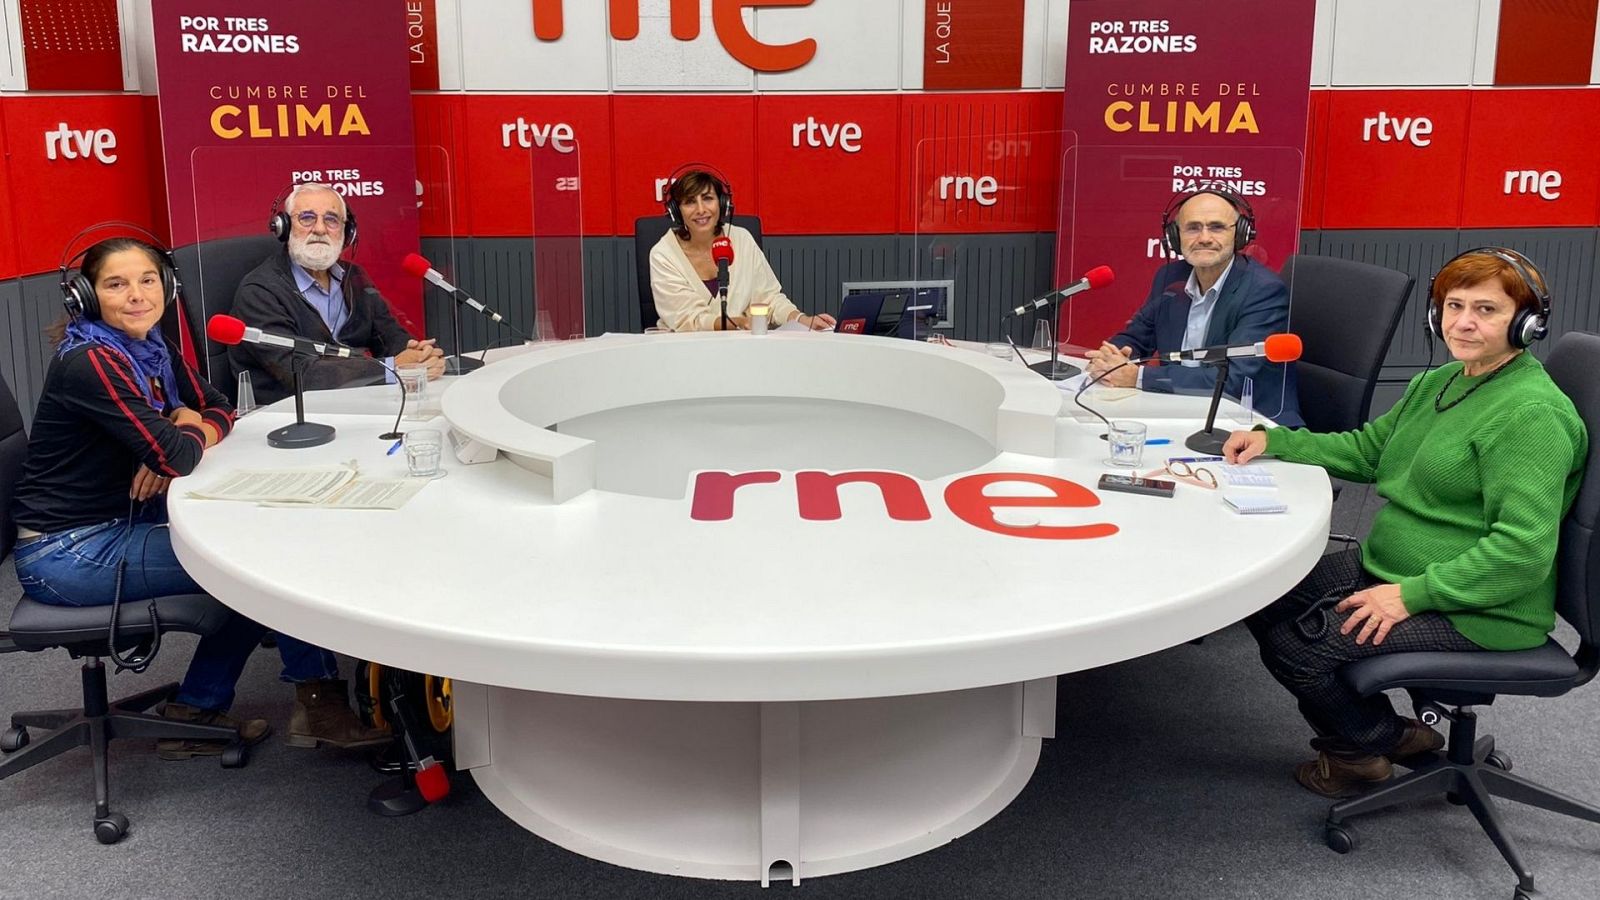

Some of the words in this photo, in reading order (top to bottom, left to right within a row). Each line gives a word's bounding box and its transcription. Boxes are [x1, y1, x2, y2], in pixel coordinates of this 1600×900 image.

[179, 15, 220, 31] POR
[224, 17, 269, 32] TRES
[407, 1, 424, 39] QUE
[936, 2, 951, 39] QUE
[1090, 21, 1125, 35] POR
[1129, 19, 1170, 34] TRES
[181, 33, 300, 54] RAZONES
[409, 42, 425, 64] LA
[935, 42, 951, 64] LA
[1089, 34, 1198, 54] RAZONES
[209, 85, 309, 100] CUMBRE
[327, 85, 367, 99] DEL
[1107, 83, 1200, 96] CUMBRE
[1219, 83, 1261, 96] DEL
[210, 103, 371, 139] CLIMA
[1104, 100, 1260, 134] CLIMA
[1363, 111, 1434, 147] rtve
[44, 122, 117, 164] rtve
[501, 117, 575, 153] rtve
[792, 116, 863, 153] rtve
[292, 170, 323, 183] POR
[325, 168, 361, 181] TRES
[1173, 165, 1204, 178] POR
[1206, 166, 1243, 179] TRES
[1503, 169, 1563, 200] rne
[293, 181, 385, 198] ONES
[939, 175, 998, 206] rne
[690, 471, 1120, 540] rne
